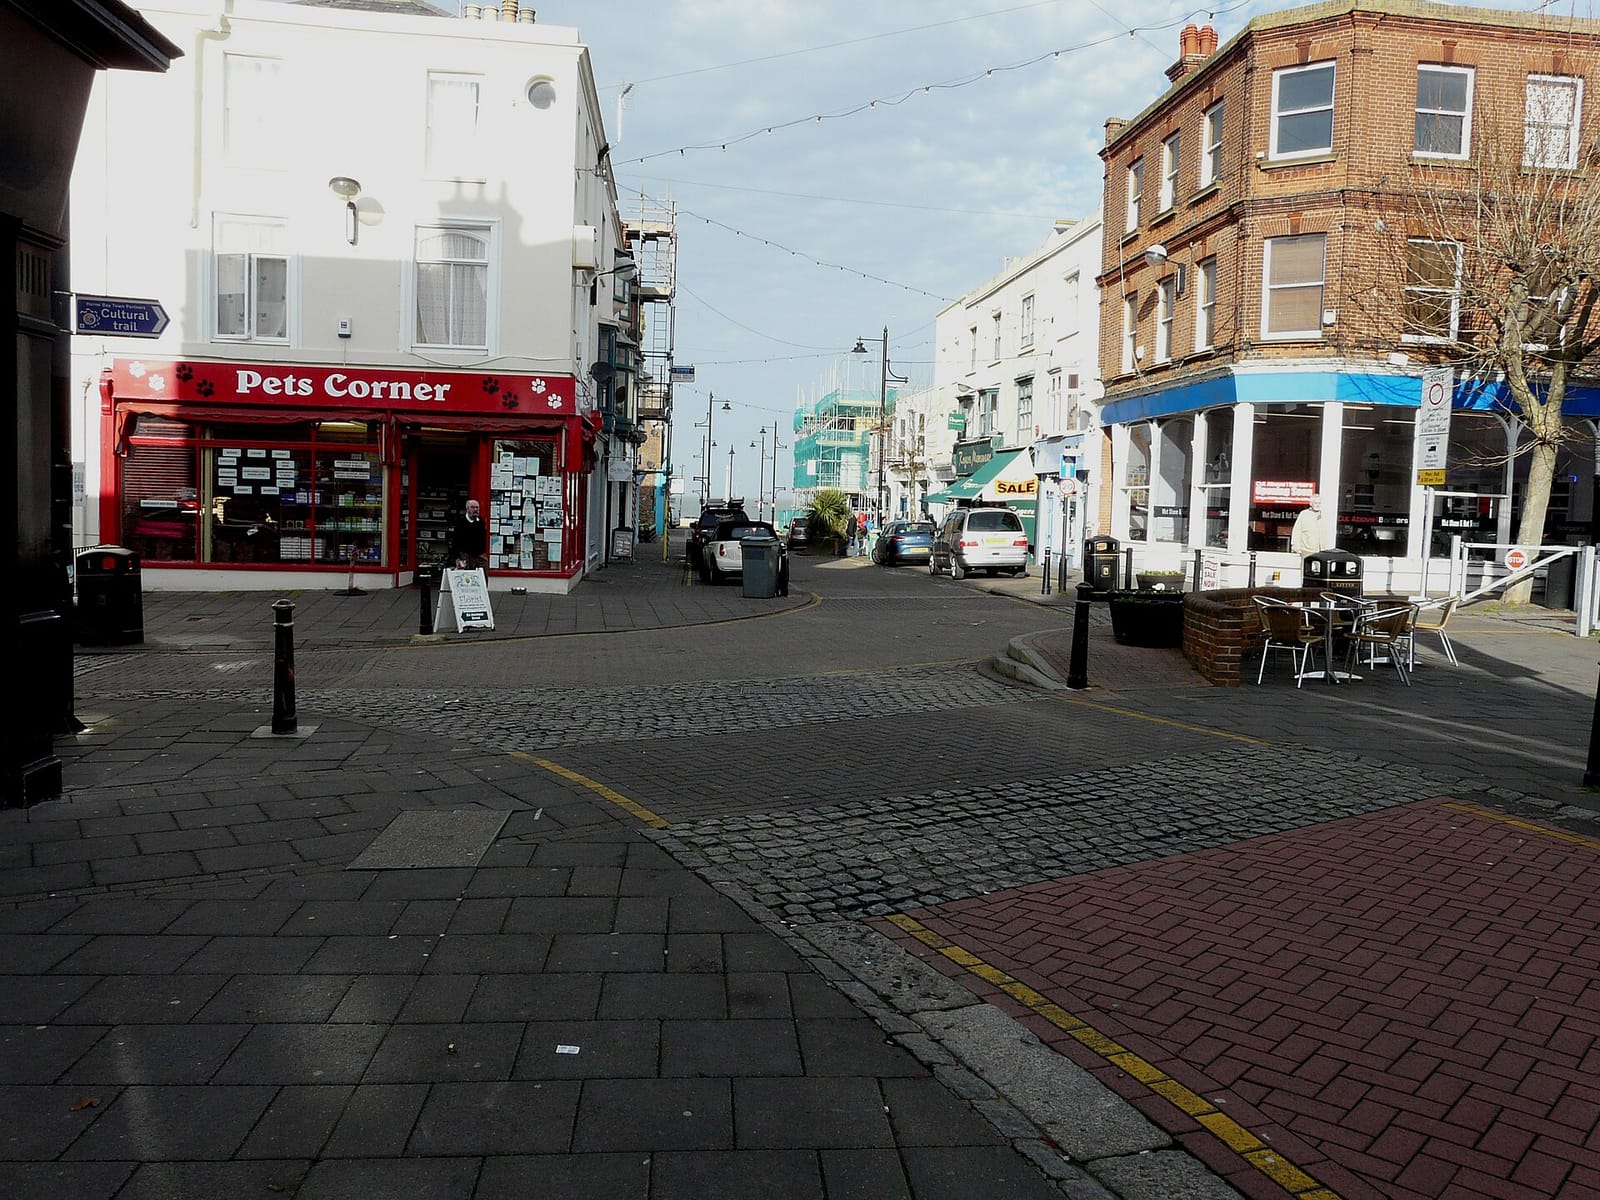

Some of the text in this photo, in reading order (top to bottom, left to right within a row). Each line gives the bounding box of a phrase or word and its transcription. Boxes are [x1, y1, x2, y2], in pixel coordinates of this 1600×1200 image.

[101, 308, 149, 320] Cultural
[113, 321, 138, 331] trail
[236, 370, 451, 401] Pets Corner
[997, 482, 1035, 494] SALE
[1508, 556, 1525, 564] STOP
[1204, 580, 1216, 588] NOW
